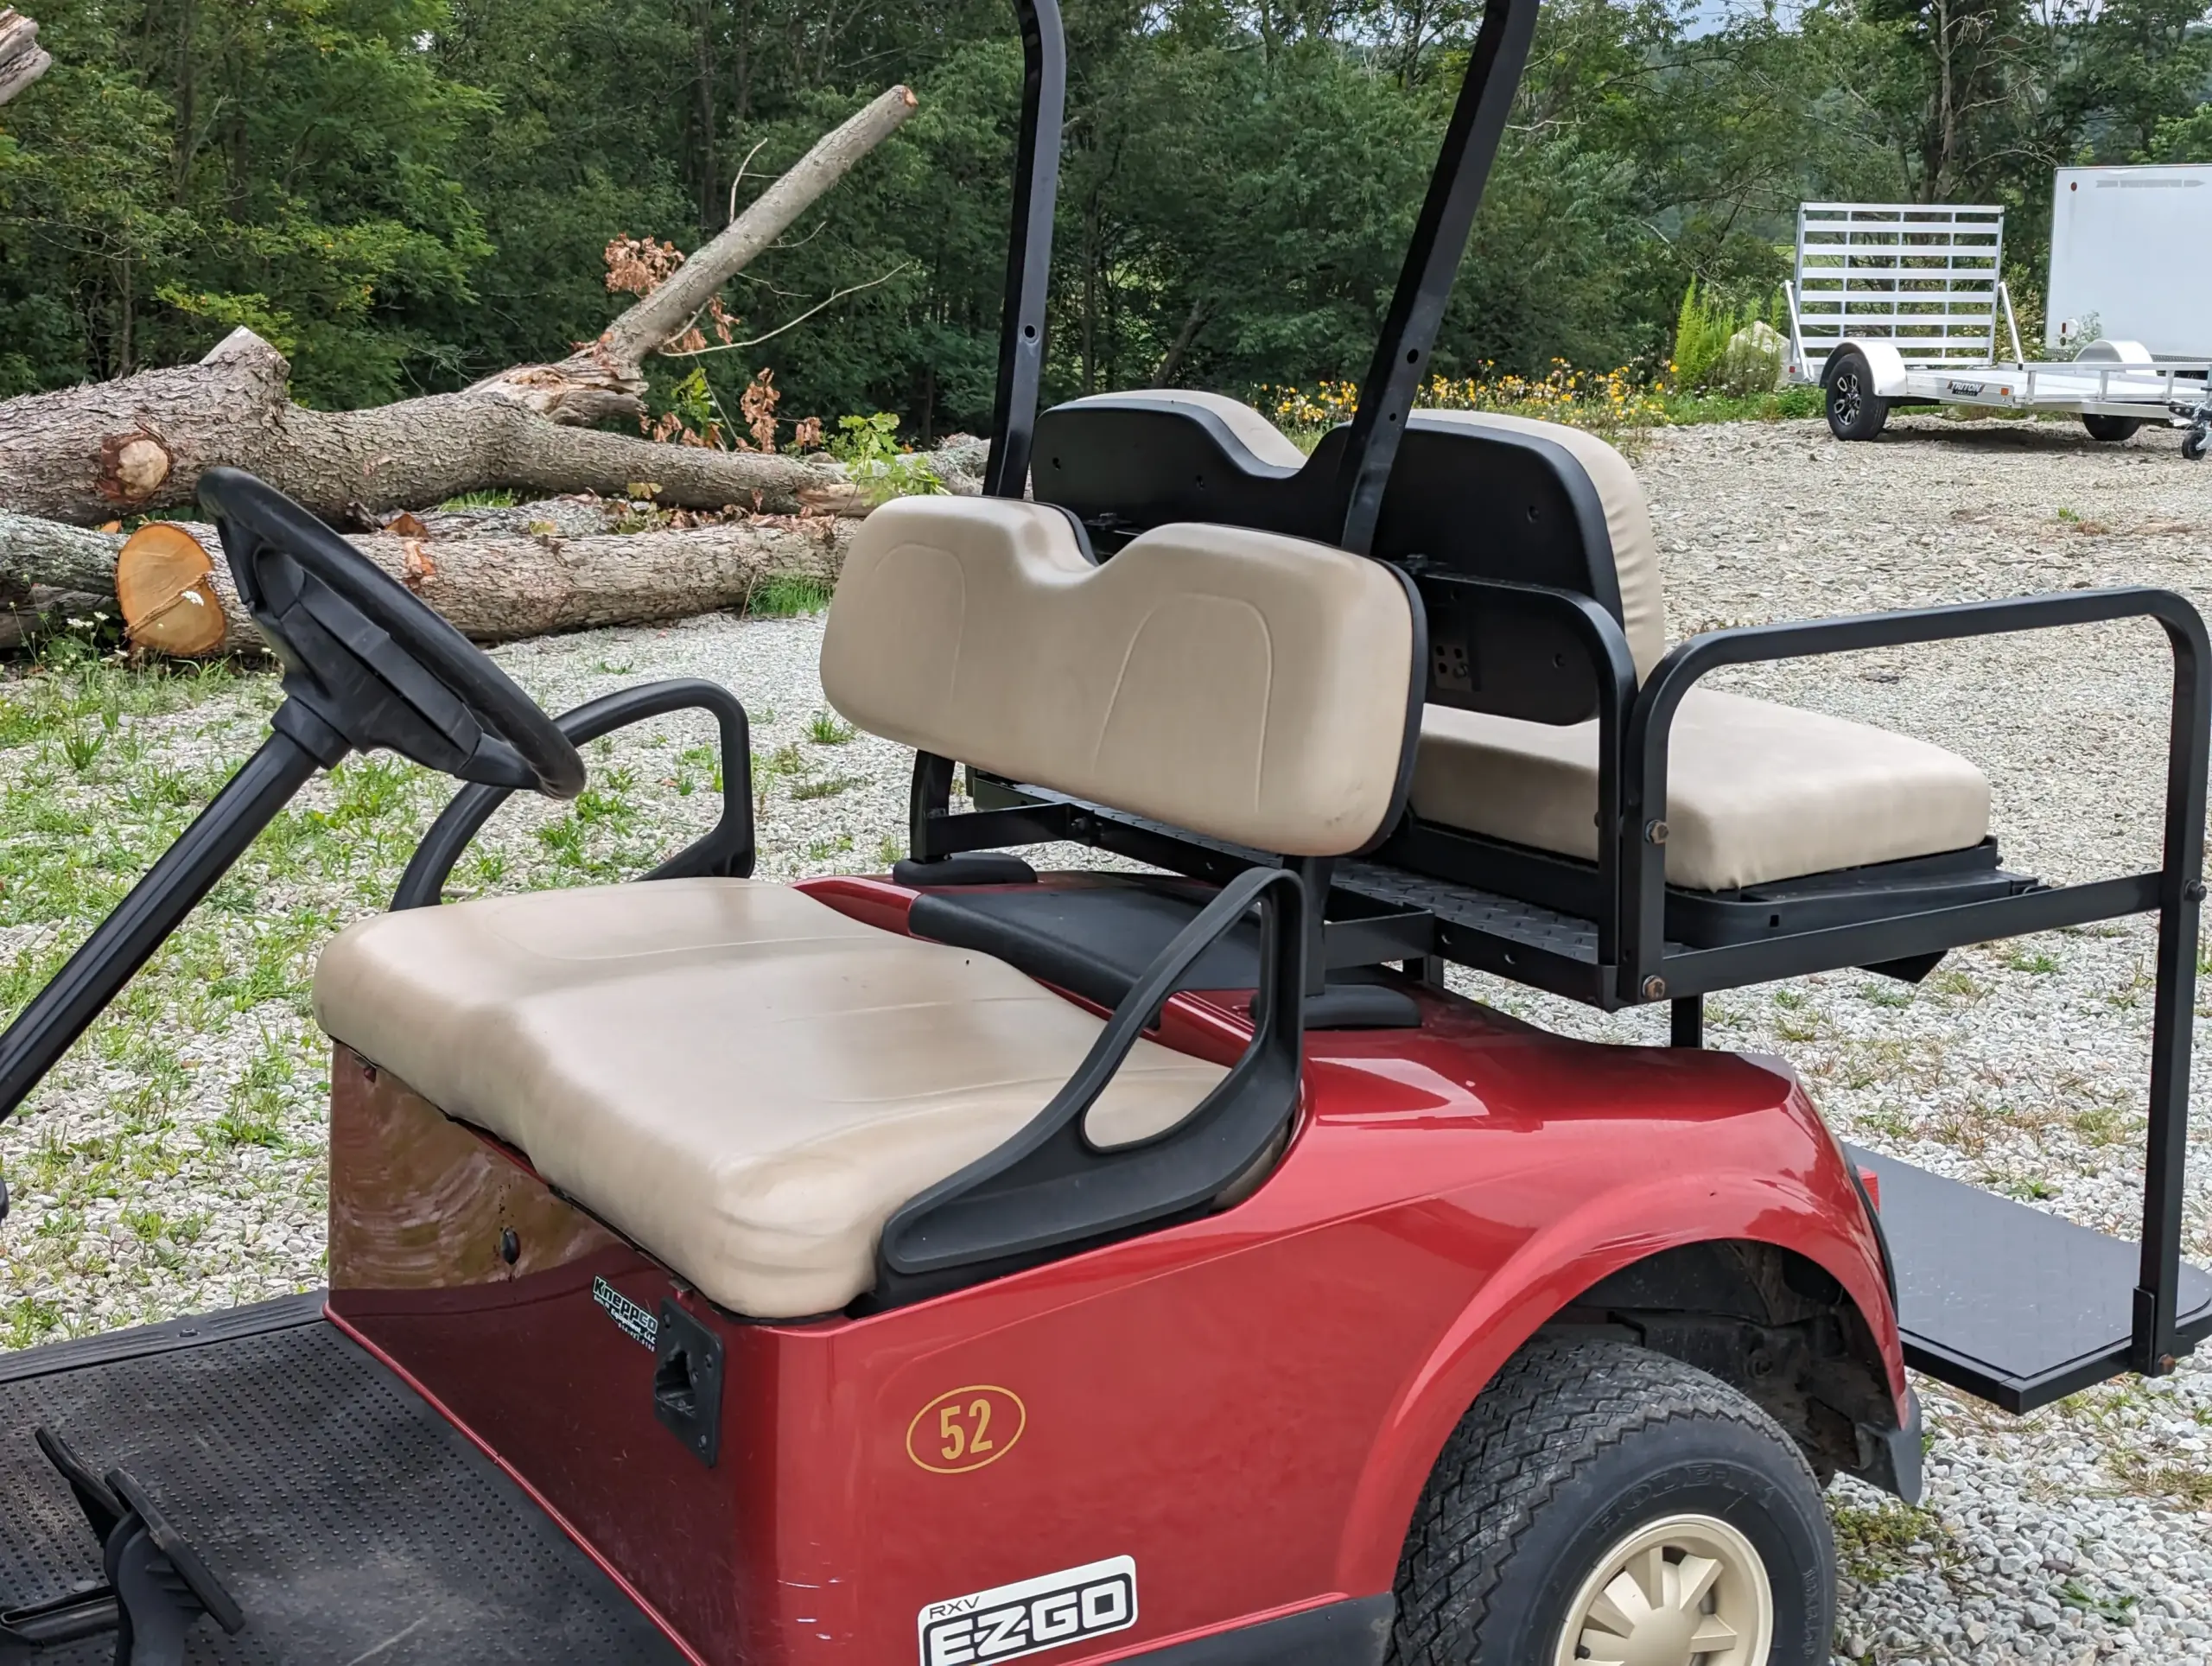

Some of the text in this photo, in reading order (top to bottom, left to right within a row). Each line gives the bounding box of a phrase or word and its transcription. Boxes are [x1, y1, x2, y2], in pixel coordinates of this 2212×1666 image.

[1951, 381, 1982, 392] TRITON
[593, 1275, 658, 1334] Kneppco
[940, 1398, 993, 1459] 52
[930, 1596, 980, 1620] RXV
